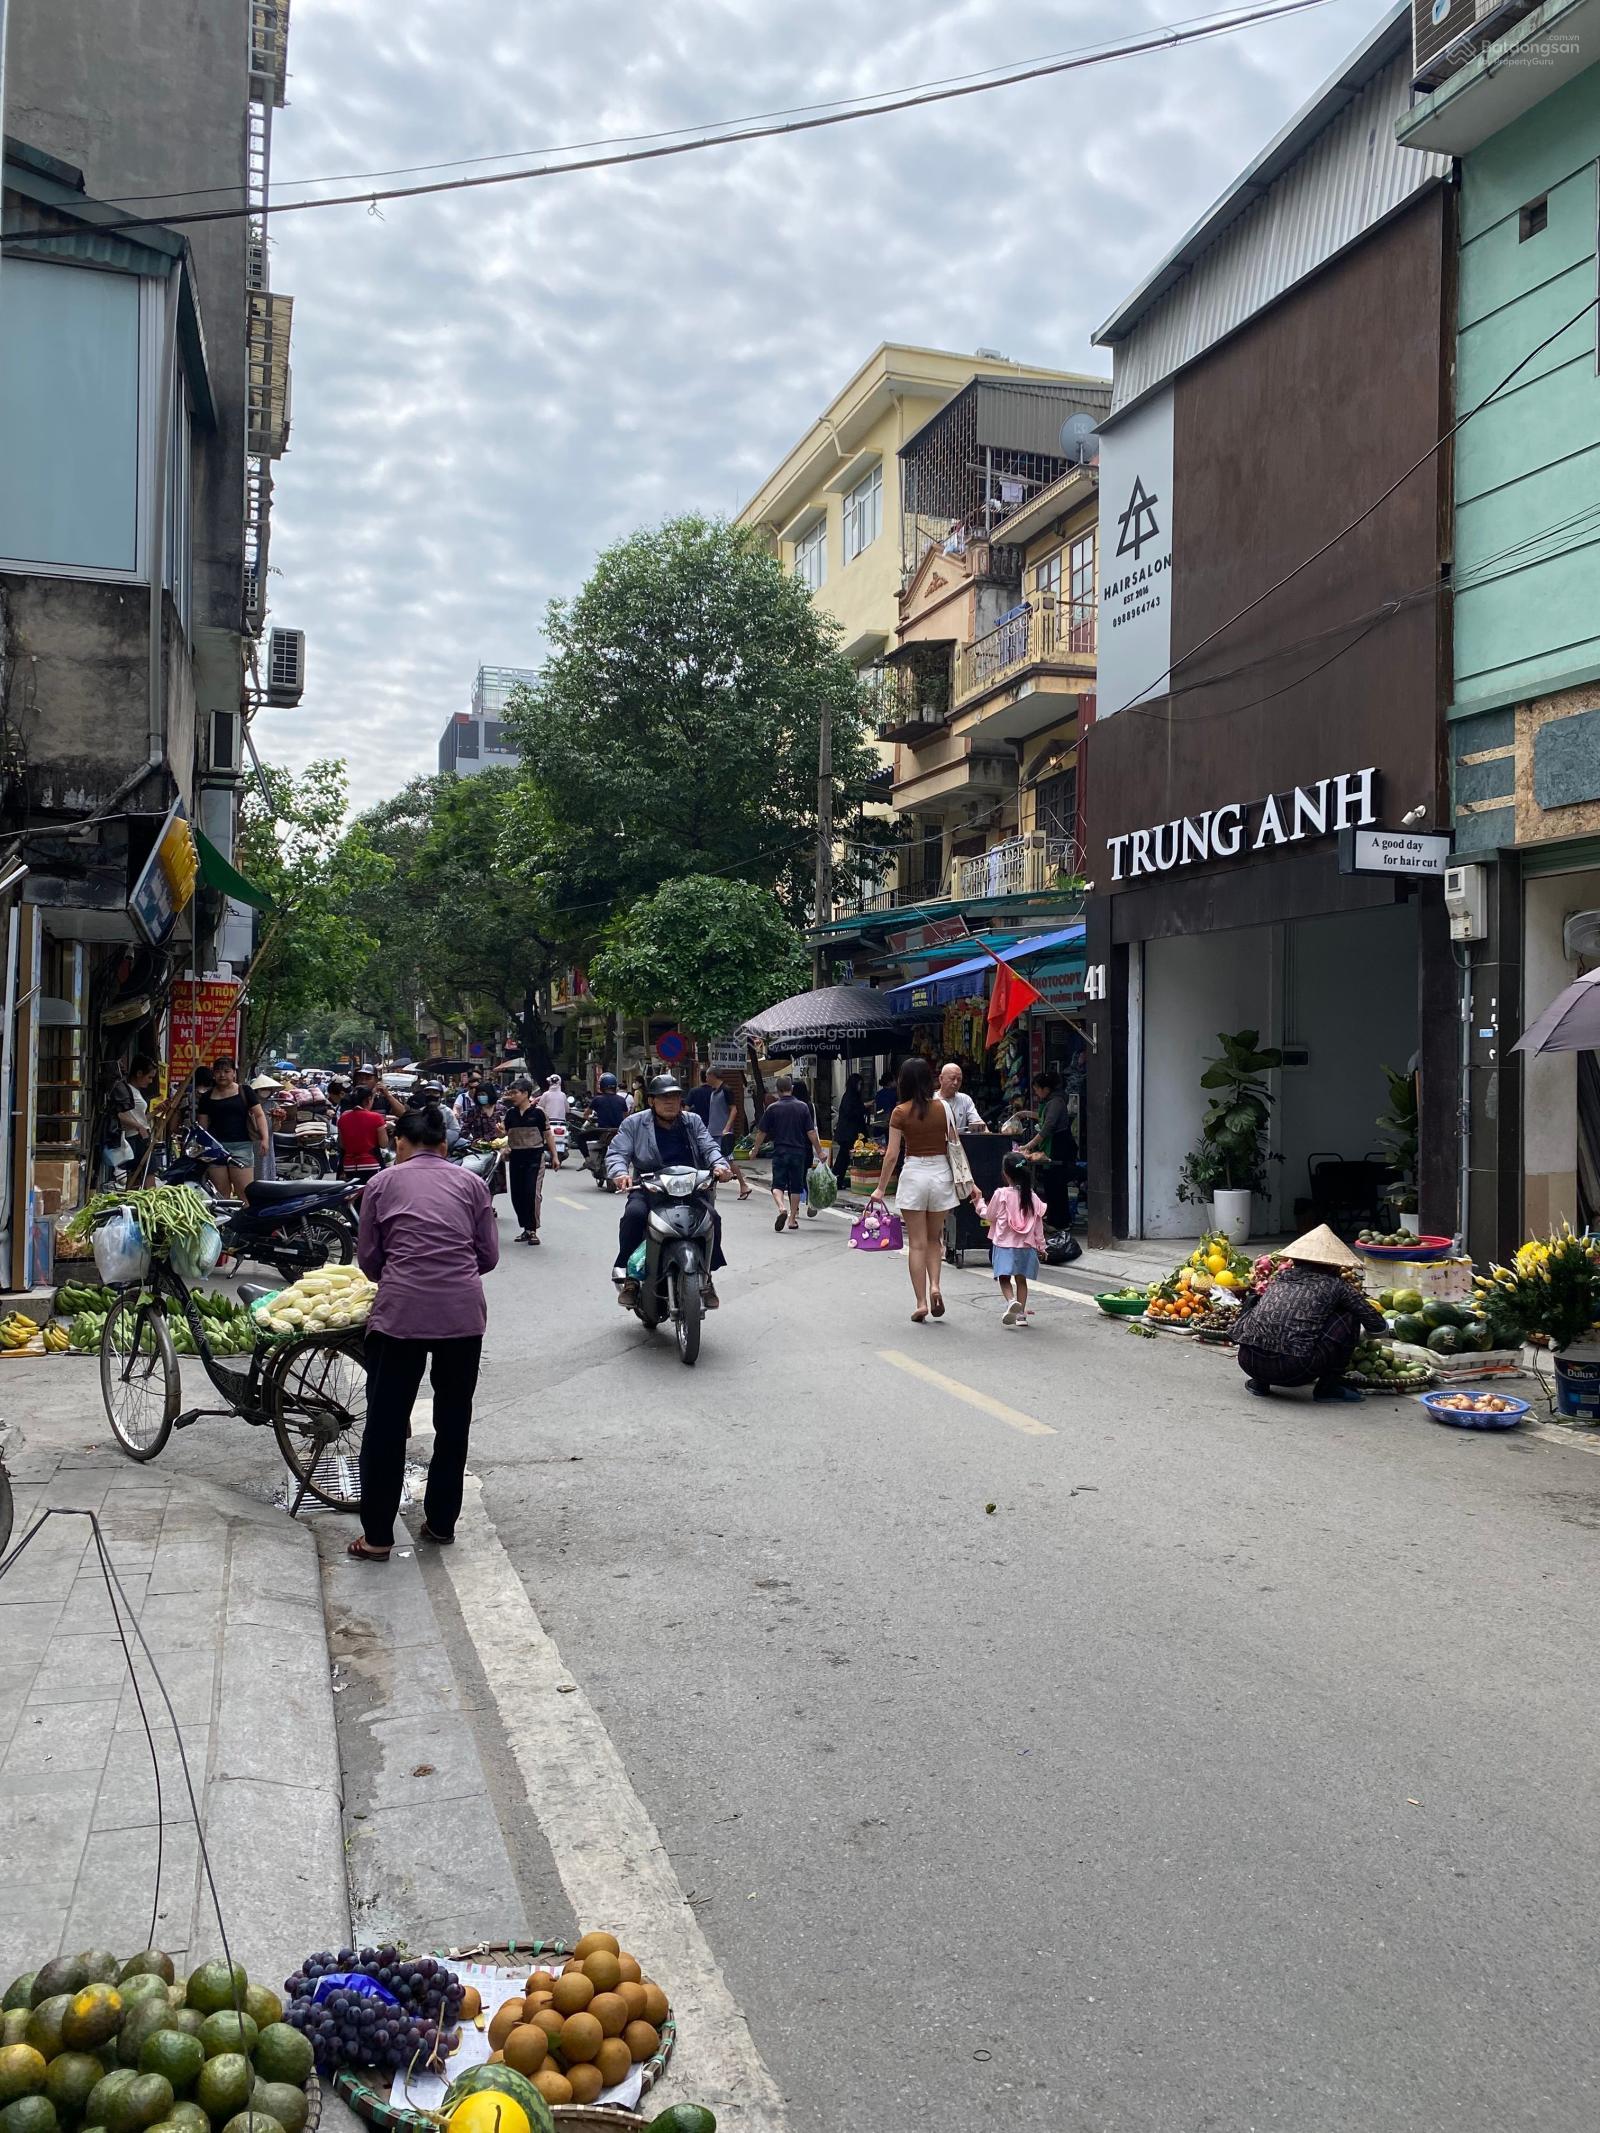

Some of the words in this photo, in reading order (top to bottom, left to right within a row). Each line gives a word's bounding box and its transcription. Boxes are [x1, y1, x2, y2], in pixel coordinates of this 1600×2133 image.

[1104, 553, 1171, 600] HAIRSALON
[1135, 585, 1149, 599] 2016
[1113, 596, 1160, 628] 0988964743
[1107, 803, 1244, 881] TRUNG
[1252, 767, 1377, 849] ANH
[1372, 838, 1379, 847] A
[1382, 839, 1404, 850] good
[1406, 839, 1424, 852] day
[1383, 854, 1398, 864] for
[1400, 855, 1421, 867] hair
[1422, 859, 1437, 868] cut
[1084, 964, 1106, 1000] 41
[1568, 1369, 1594, 1378] Dulux
